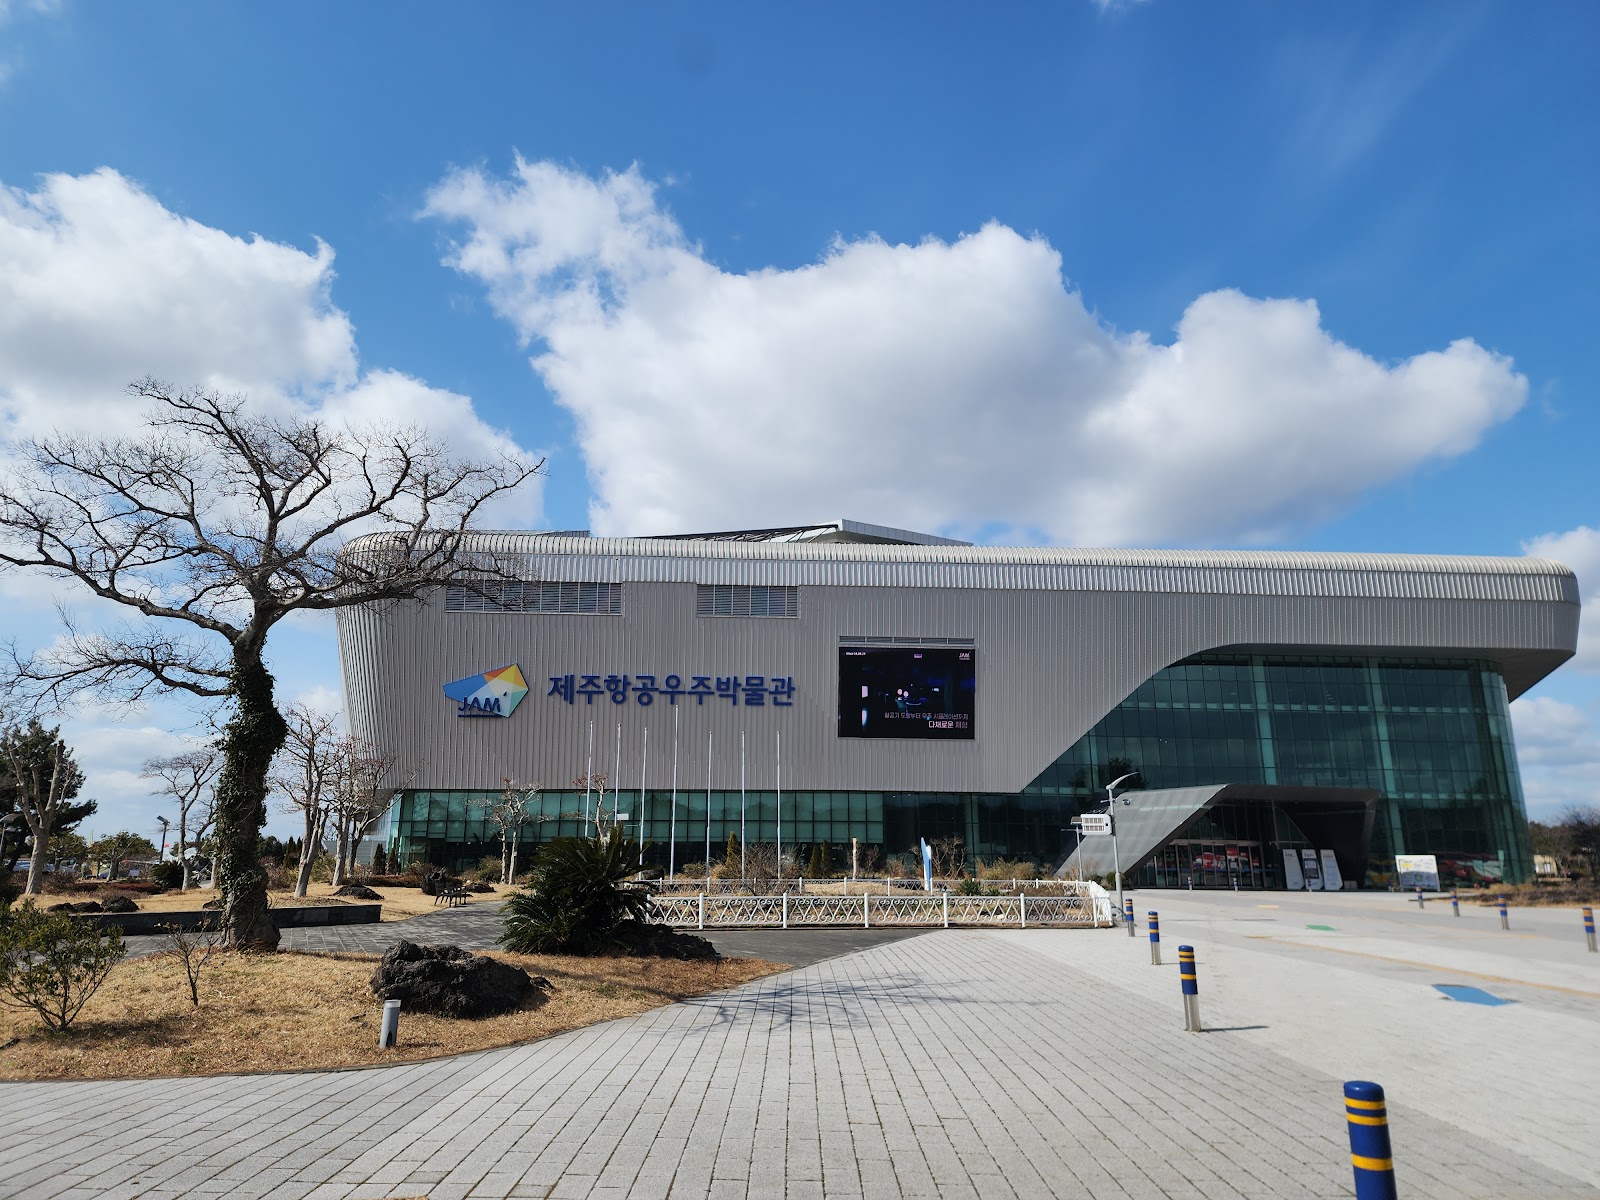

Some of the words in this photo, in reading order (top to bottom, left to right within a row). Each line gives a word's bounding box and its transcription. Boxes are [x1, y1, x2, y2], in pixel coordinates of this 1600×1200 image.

[547, 674, 795, 707] 제주항공우주박물관
[457, 697, 501, 712] JAM
[928, 720, 954, 729] 다채로운
